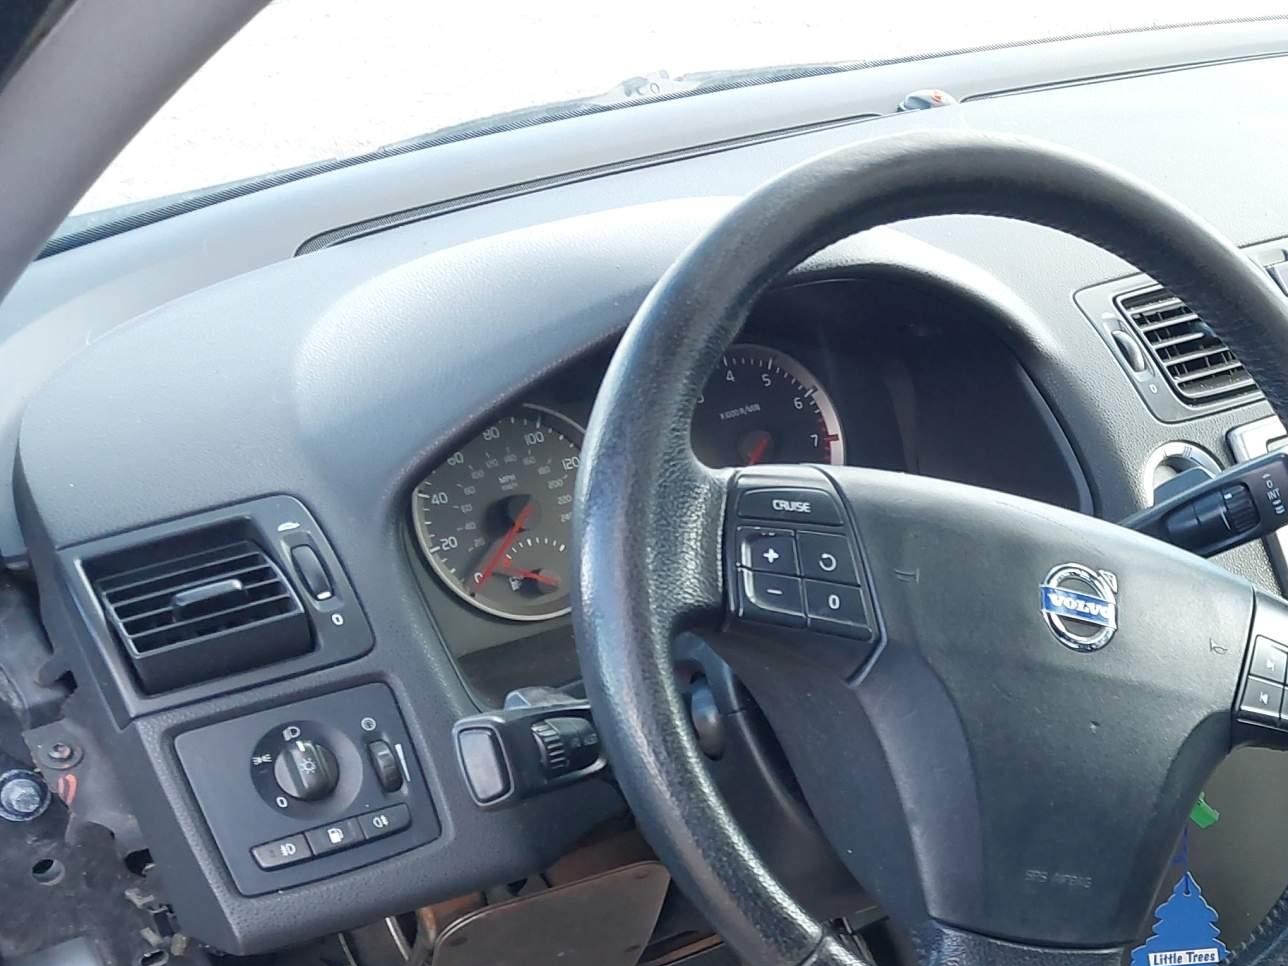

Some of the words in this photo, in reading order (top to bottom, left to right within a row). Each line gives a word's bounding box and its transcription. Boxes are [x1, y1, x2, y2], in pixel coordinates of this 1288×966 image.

[726, 370, 735, 382] 4
[761, 373, 772, 387] 5
[793, 397, 804, 410] 6
[483, 426, 500, 441] 80
[524, 431, 545, 446] 100
[810, 434, 819, 448] 7
[447, 451, 464, 467] 60
[561, 456, 580, 471] 120
[499, 474, 517, 484] MPH
[431, 492, 449, 506] 40
[1267, 488, 1281, 501] INT
[772, 499, 811, 513] CRUISE
[440, 537, 458, 551] 20
[828, 594, 840, 609] 0
[1047, 593, 1112, 620] VOLVO
[331, 613, 344, 626] 0
[275, 796, 288, 808] 0
[1153, 953, 1183, 966] Little
[1185, 951, 1216, 963] Trees
